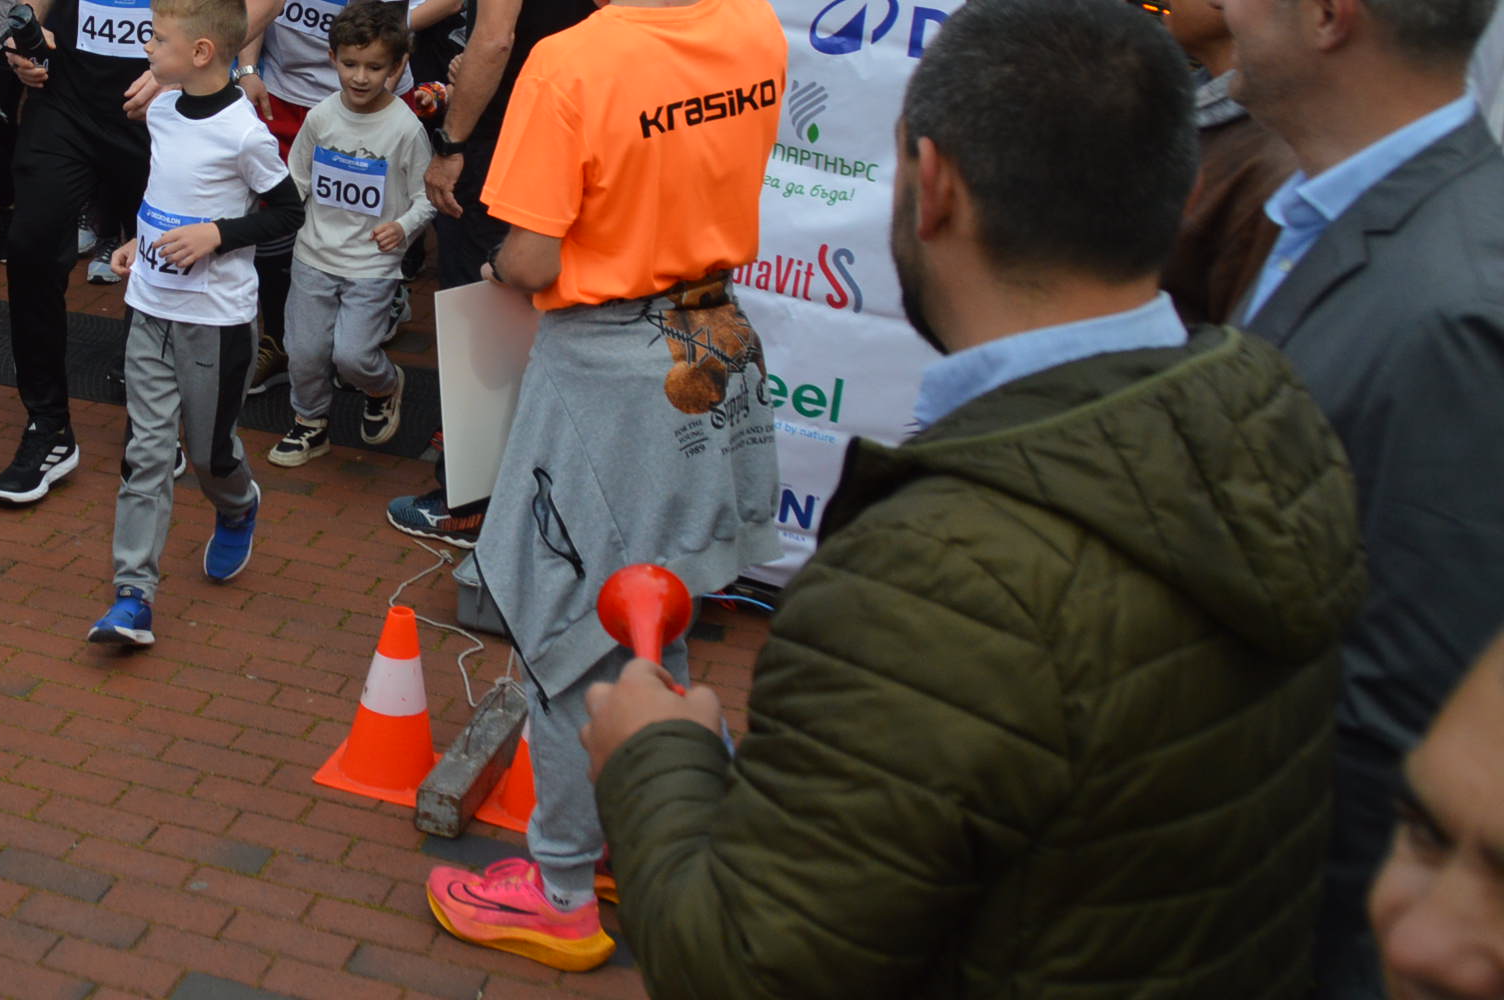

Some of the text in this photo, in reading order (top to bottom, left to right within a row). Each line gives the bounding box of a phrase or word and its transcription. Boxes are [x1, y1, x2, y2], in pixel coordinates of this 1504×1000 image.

[82, 15, 153, 45] 4426
[280, 2, 334, 33] 098
[772, 142, 879, 182] ПАРТНЪРС
[316, 175, 381, 209] 5100
